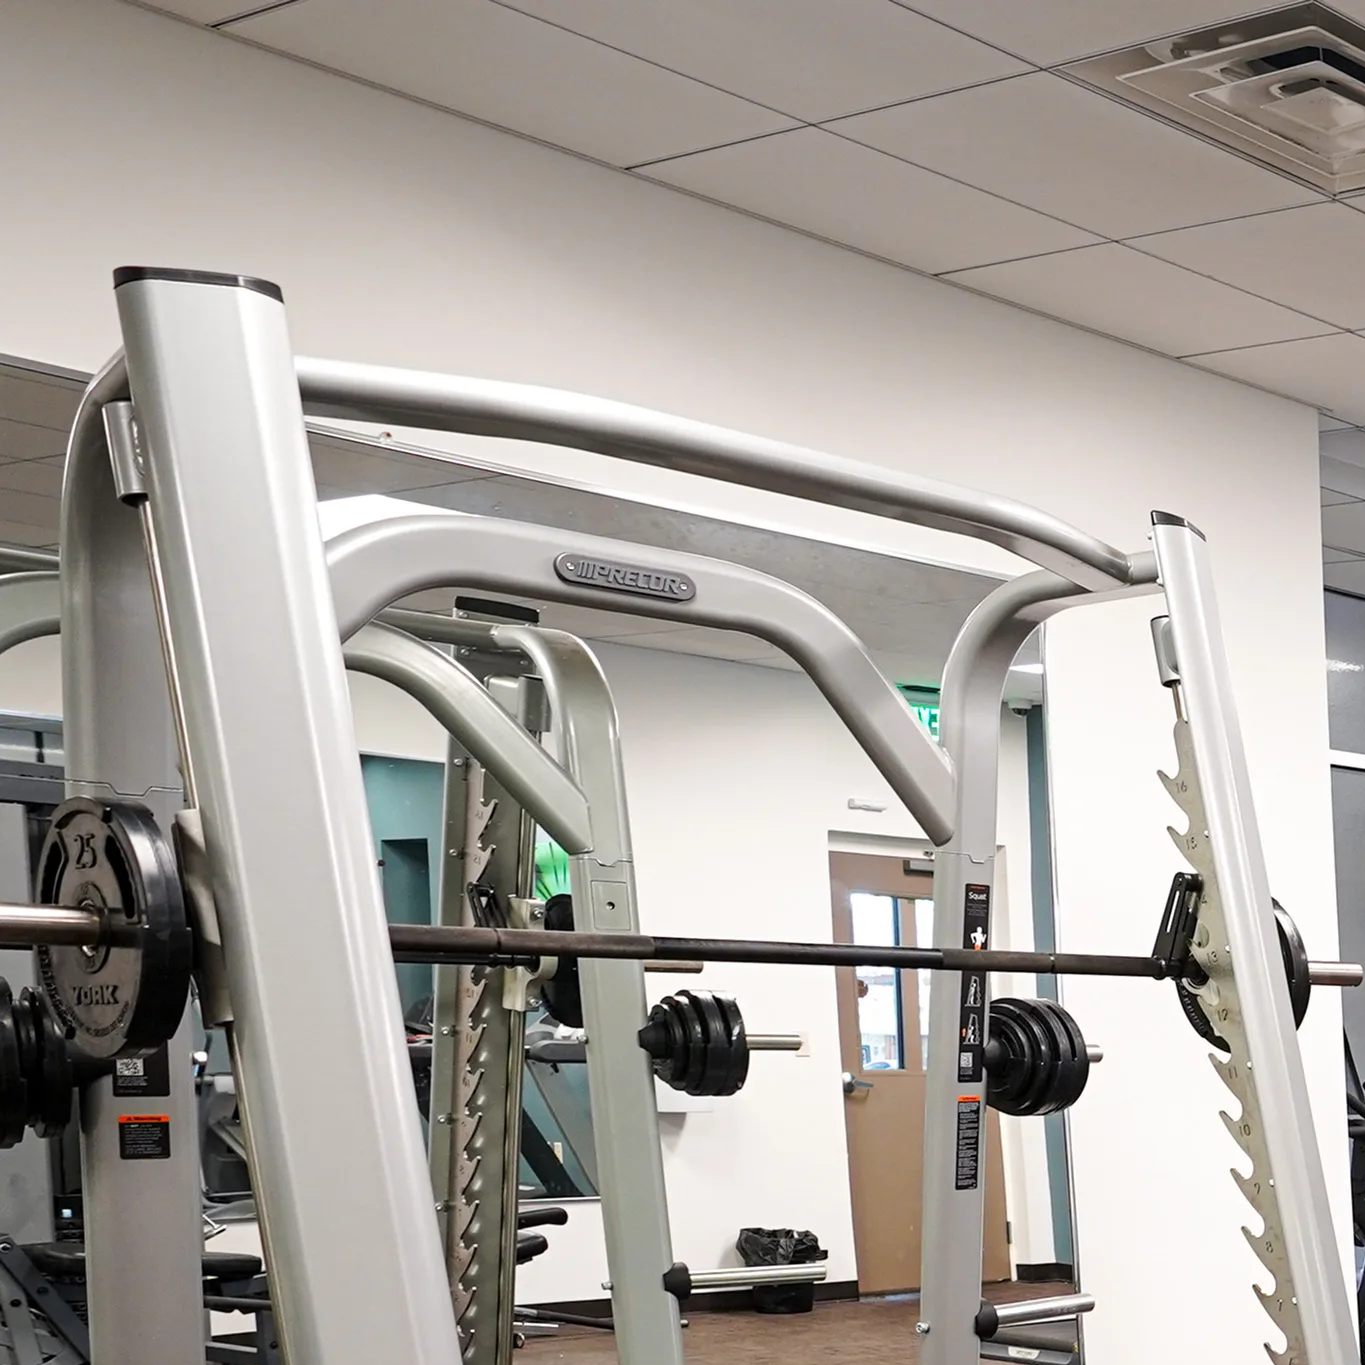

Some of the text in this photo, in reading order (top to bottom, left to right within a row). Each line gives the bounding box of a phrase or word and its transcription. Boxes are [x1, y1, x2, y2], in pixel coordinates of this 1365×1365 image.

[590, 560, 682, 595] PRECOR
[1176, 780, 1188, 794] 16
[1186, 836, 1198, 851] 15
[74, 834, 98, 870] 25
[968, 891, 987, 900] Squat
[73, 985, 119, 1005] YORK
[1217, 1008, 1229, 1022] 12
[1227, 1066, 1239, 1080] 11
[1239, 1123, 1252, 1137] 10
